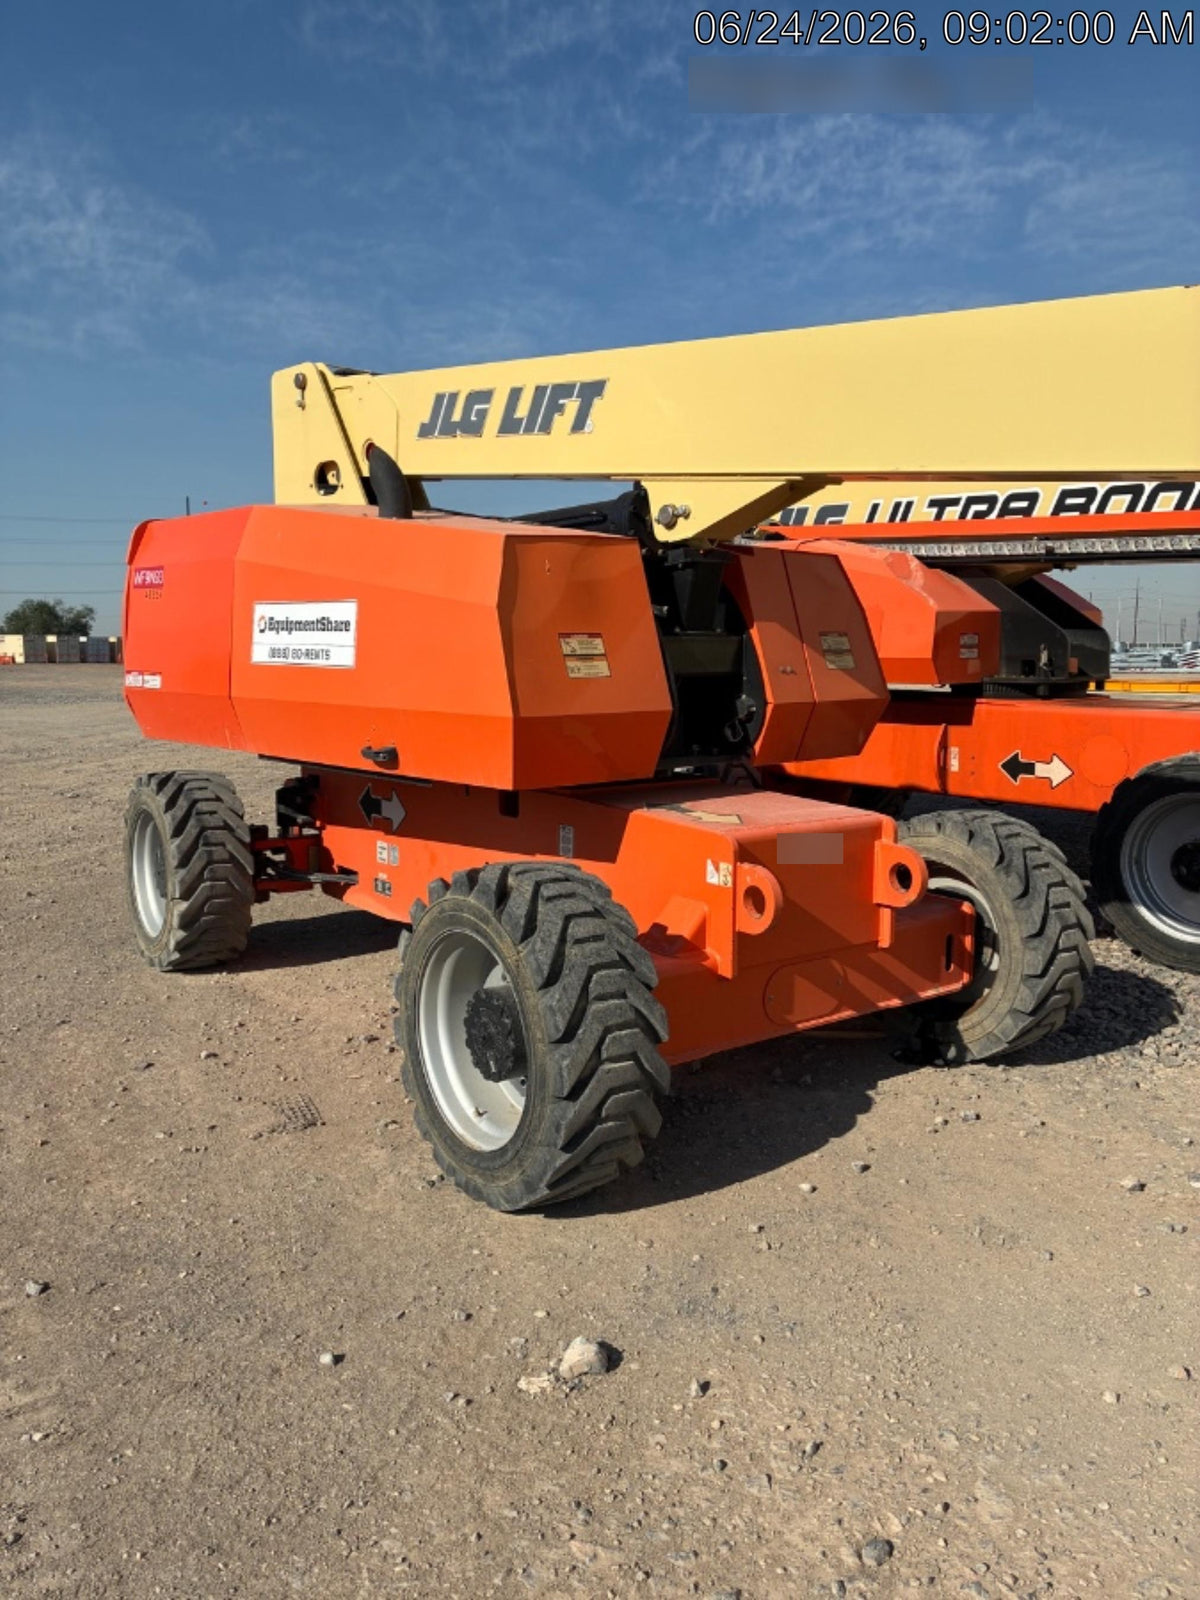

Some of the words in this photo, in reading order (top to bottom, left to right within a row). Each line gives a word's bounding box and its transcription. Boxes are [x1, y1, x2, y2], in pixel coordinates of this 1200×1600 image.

[417, 388, 495, 439] JLG
[497, 378, 609, 435] LIFT
[268, 616, 351, 635] EquipmentShare
